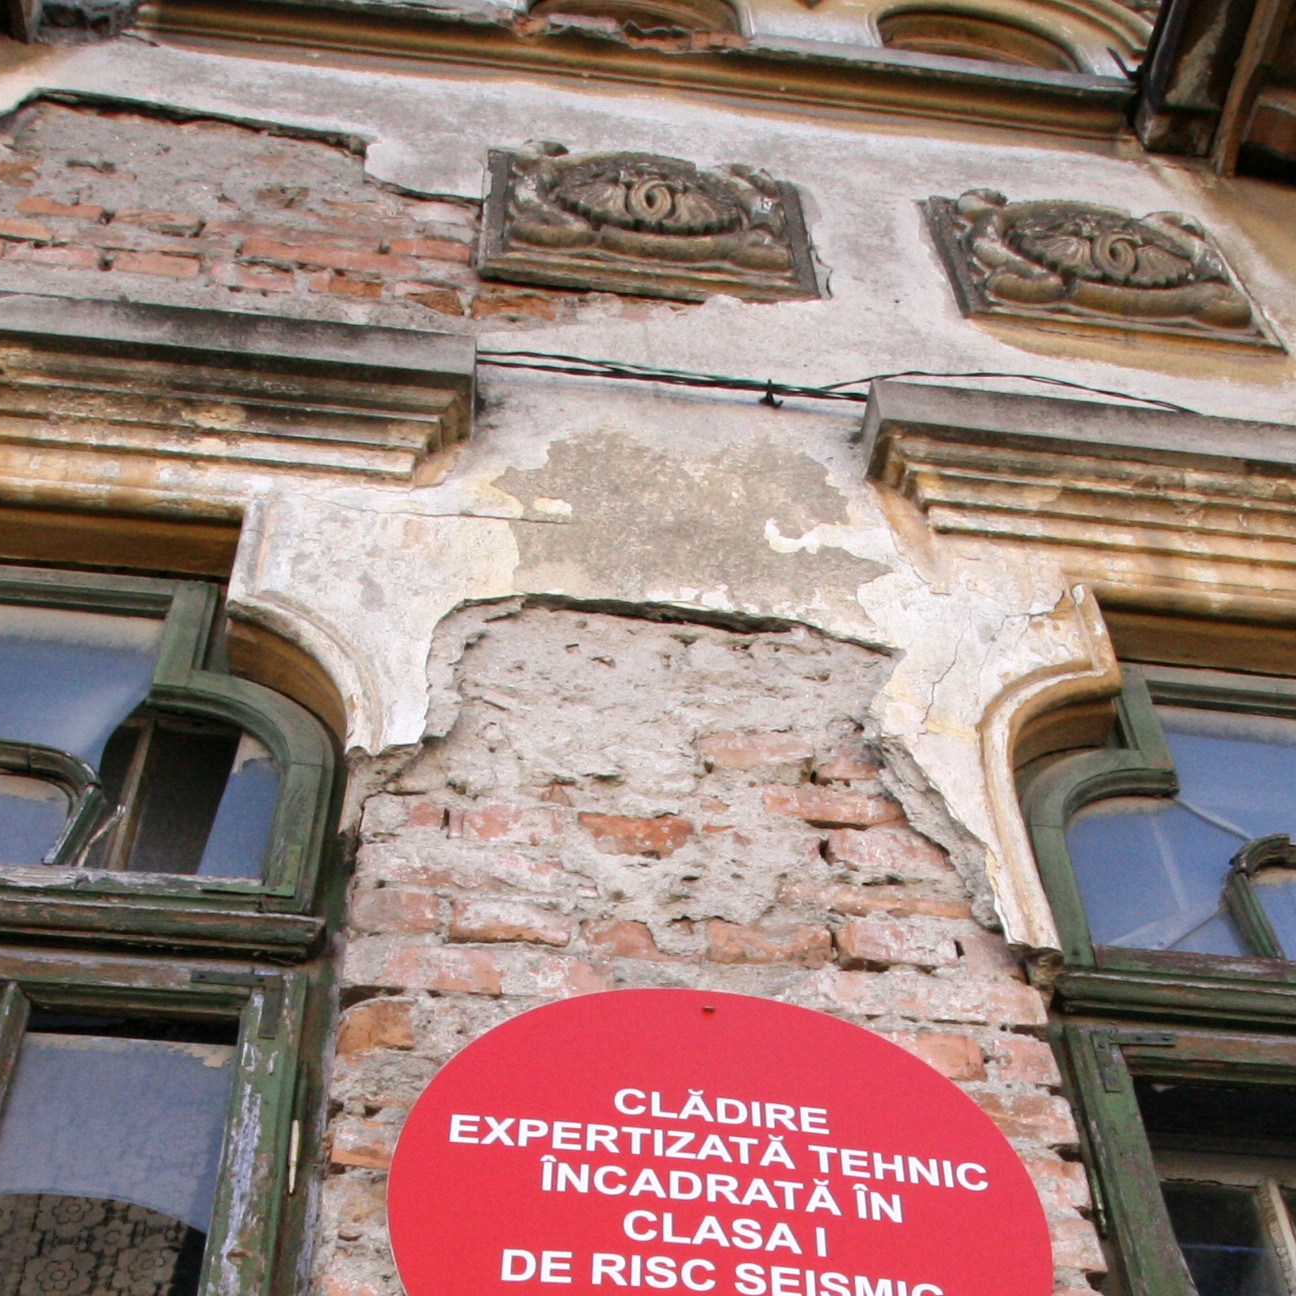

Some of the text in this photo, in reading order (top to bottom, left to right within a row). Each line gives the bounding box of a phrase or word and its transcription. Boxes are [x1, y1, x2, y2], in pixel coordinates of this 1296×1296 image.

[613, 1088, 830, 1135] CLĂDIRE
[449, 1113, 989, 1192] EXPERTIZATĂ TEHNIC
[539, 1154, 903, 1224] ÎNCADRATĂ ÎN
[623, 1209, 827, 1258] CLASA I
[500, 1248, 573, 1284] DE
[591, 1252, 716, 1292] RISC
